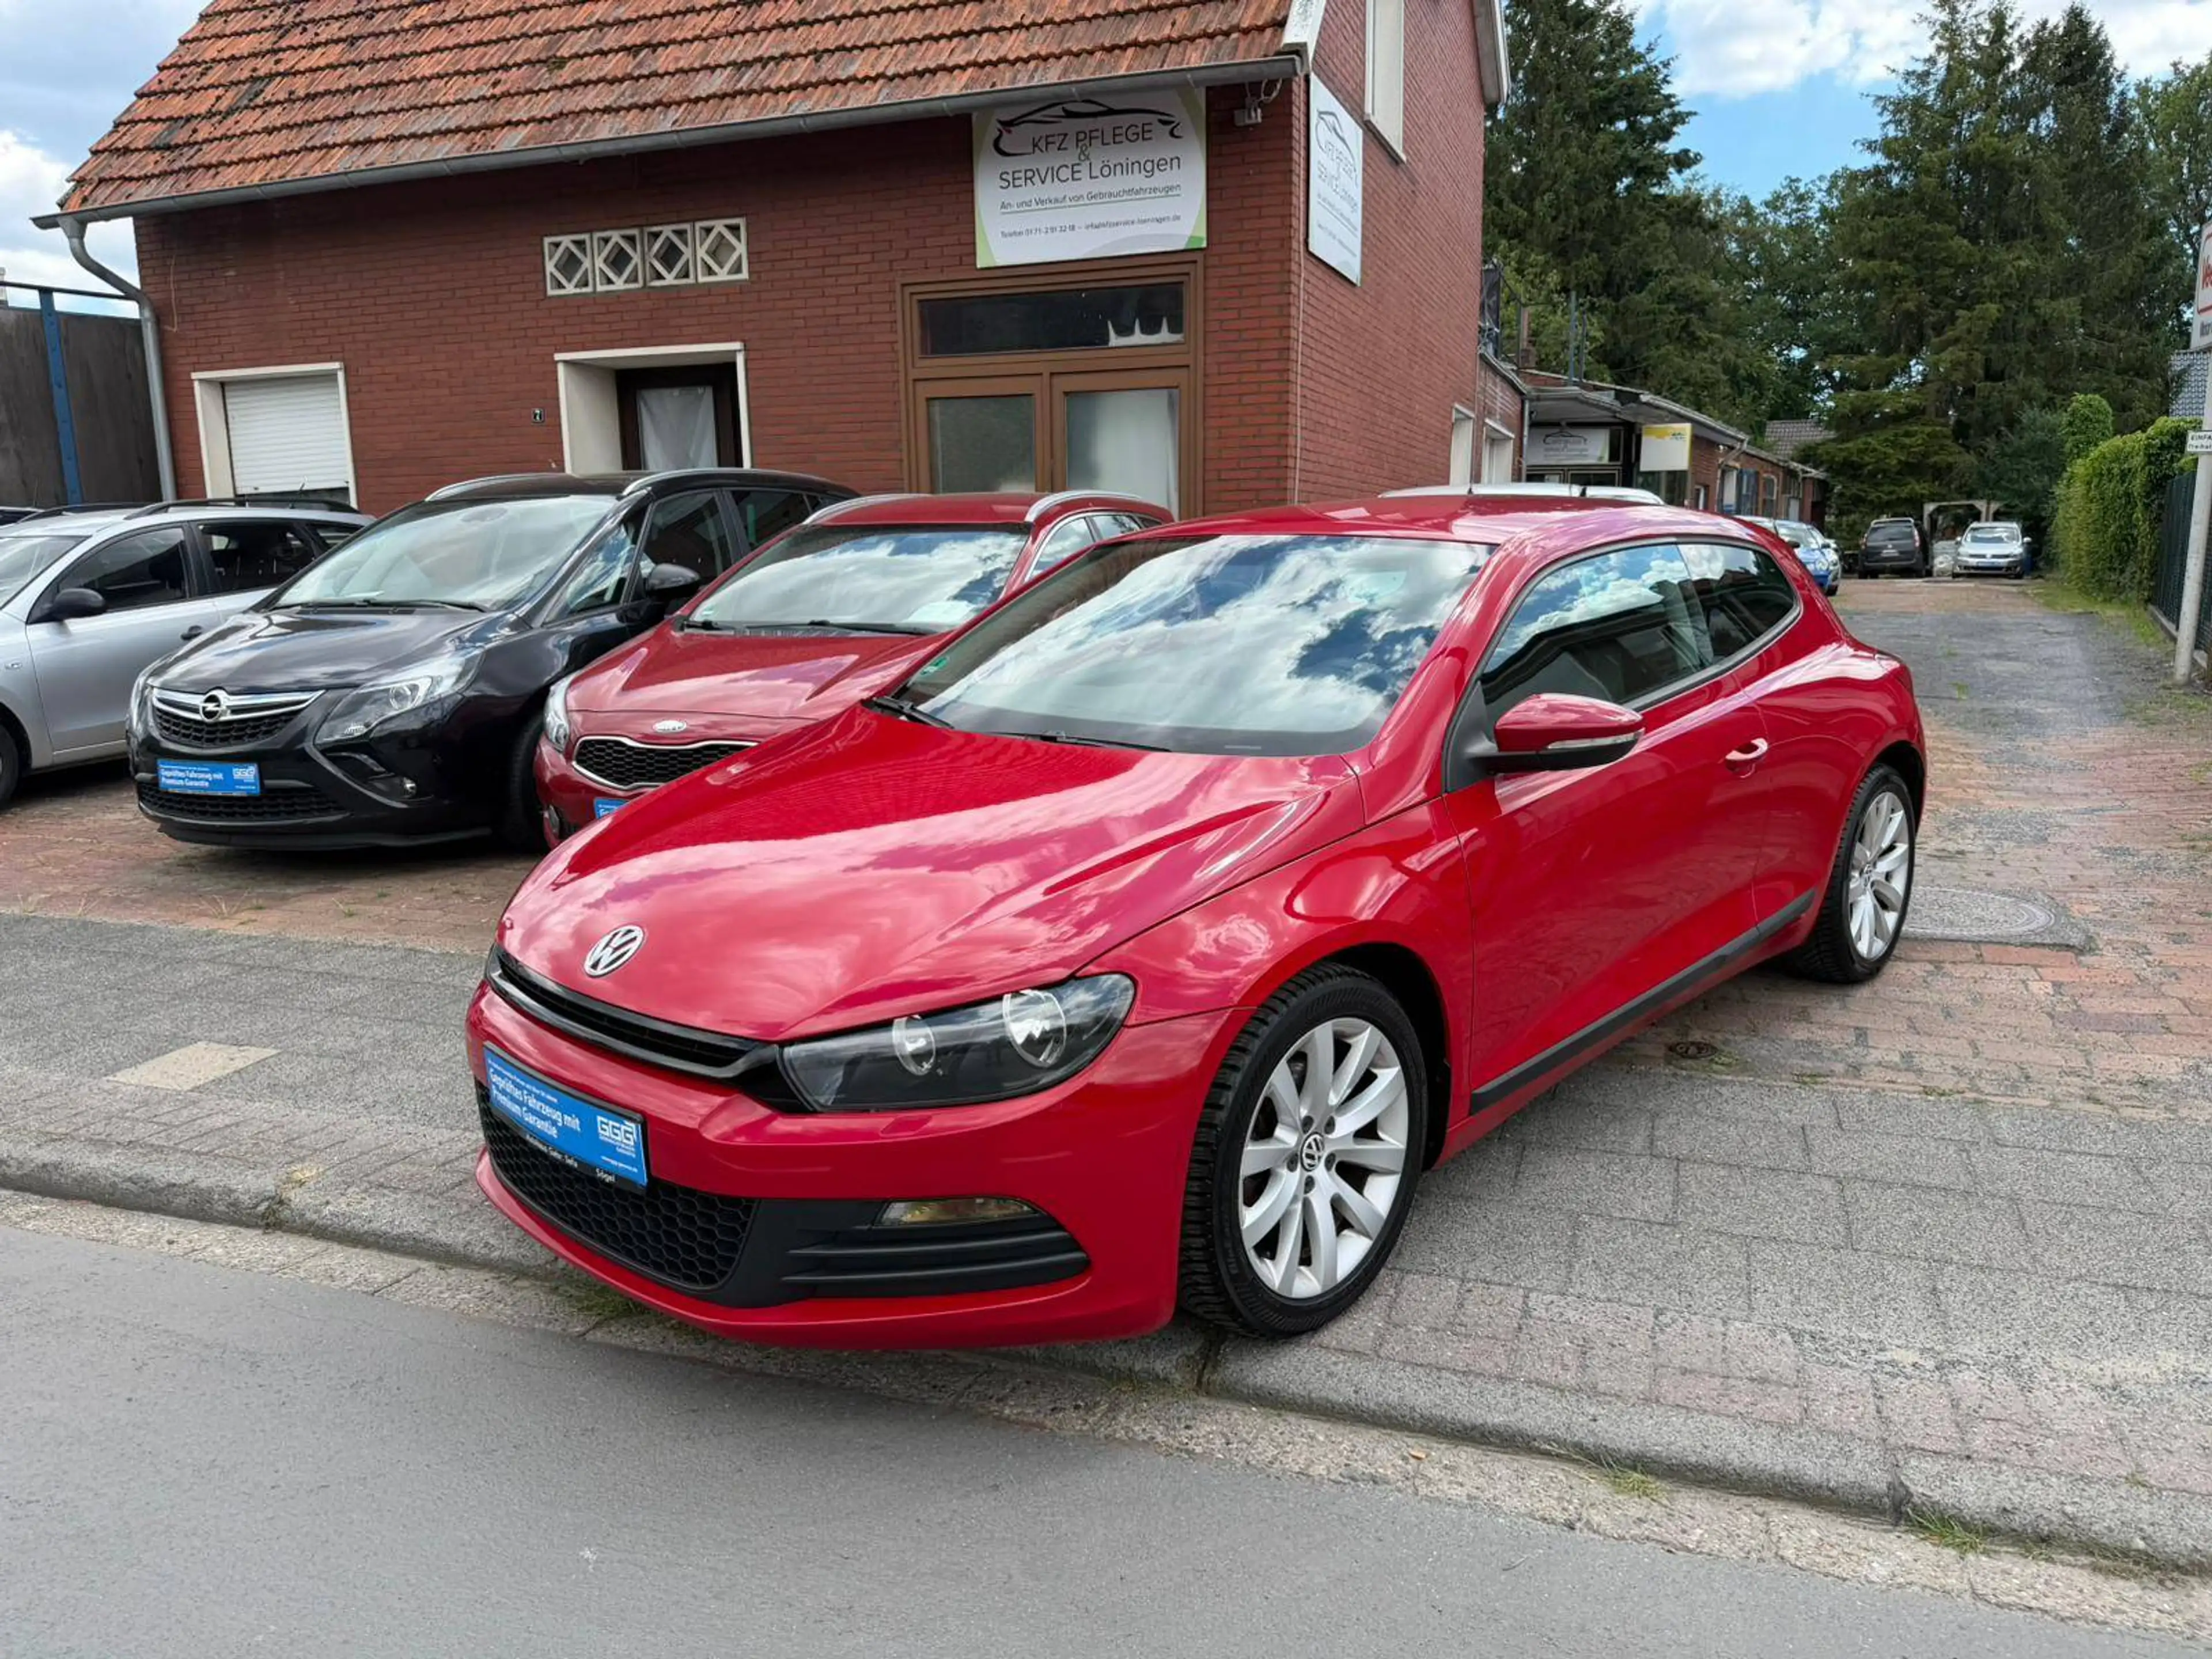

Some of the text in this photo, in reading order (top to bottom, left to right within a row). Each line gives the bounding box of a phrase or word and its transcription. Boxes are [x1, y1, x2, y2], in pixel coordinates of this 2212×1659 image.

[1032, 122, 1153, 154] KFZ PFLEGE
[1078, 143, 1090, 162] &
[999, 156, 1181, 190] SERVICE Löningen
[1016, 198, 1032, 209] und
[1034, 195, 1067, 207] Verkauf
[1086, 184, 1181, 202] Gebrauchtfahrzeugen
[522, 1106, 558, 1138] Garantie
[524, 1089, 563, 1127] Fahrzeug
[563, 1113, 581, 1132] mit
[597, 1115, 635, 1145] GGG
